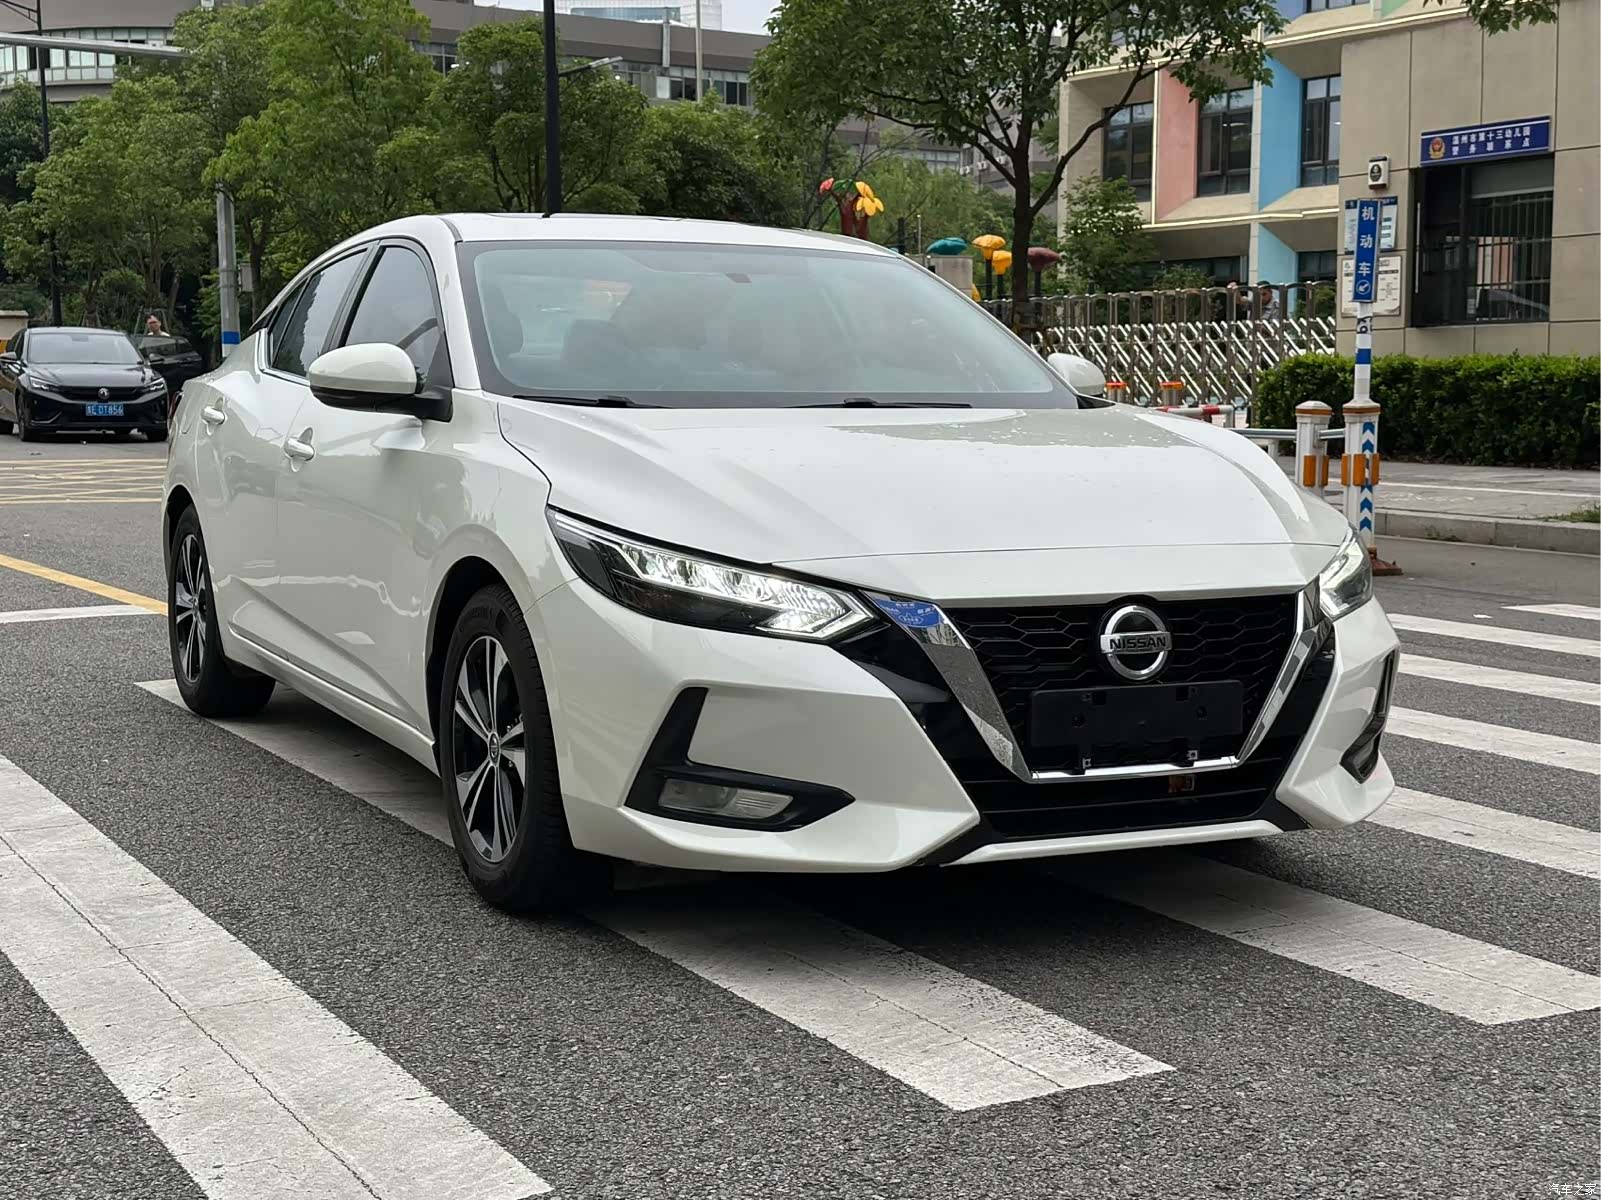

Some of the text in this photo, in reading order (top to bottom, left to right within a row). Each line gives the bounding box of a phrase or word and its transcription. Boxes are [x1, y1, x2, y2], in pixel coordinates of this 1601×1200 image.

[1451, 126, 1531, 146] 温州市第十三幼儿园
[1357, 206, 1376, 277] 机动车
[1109, 636, 1167, 650] NISSAN
